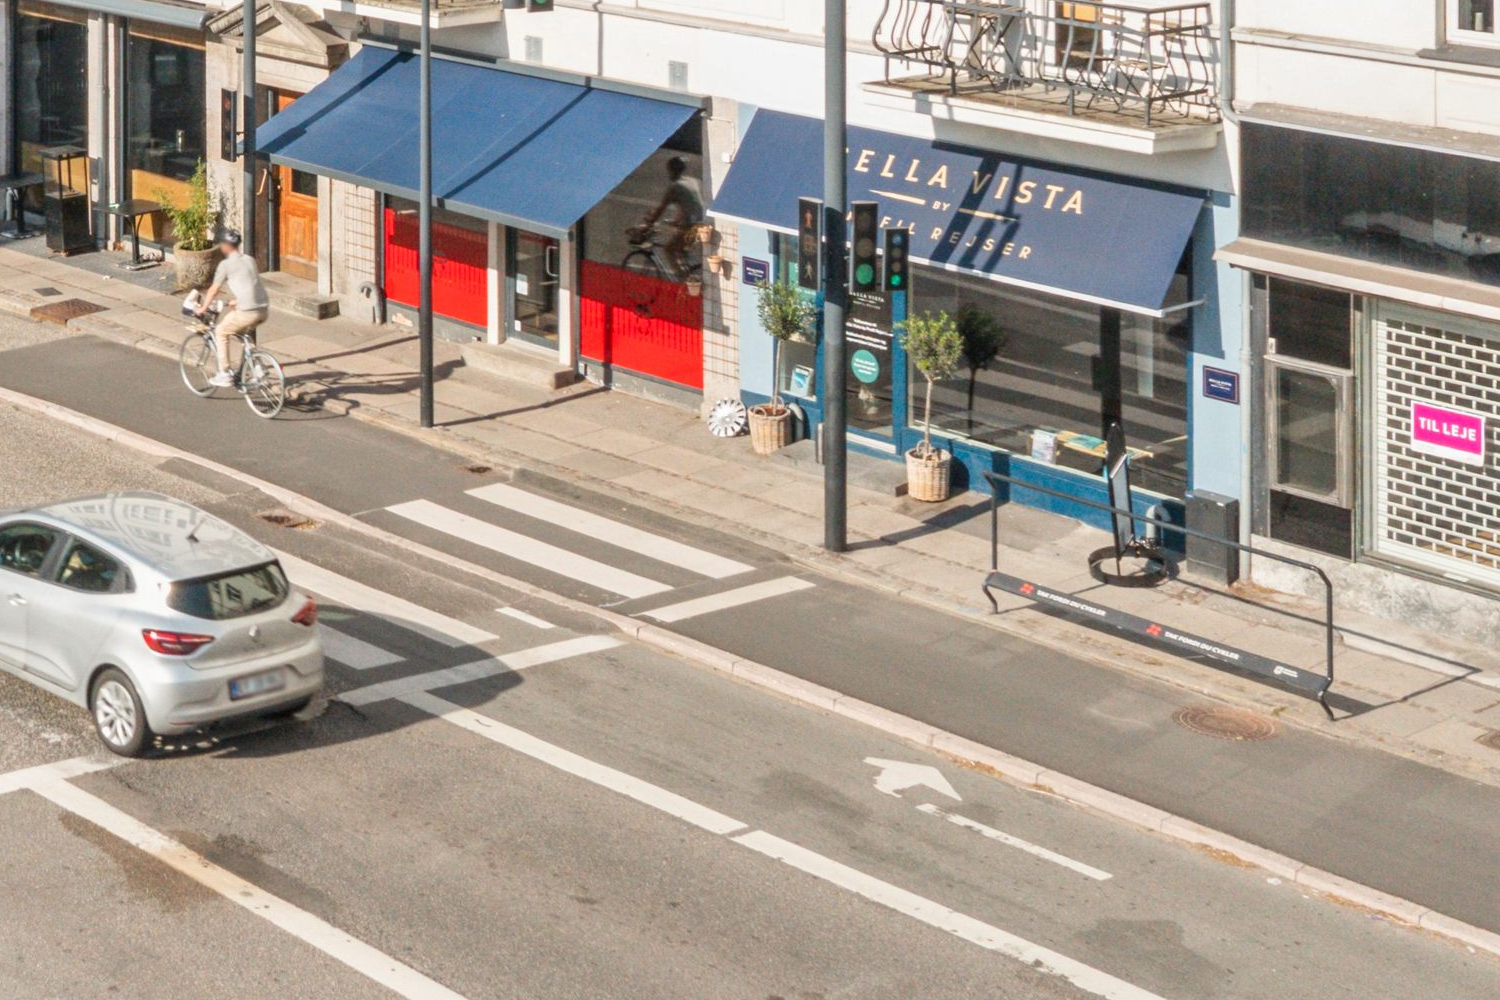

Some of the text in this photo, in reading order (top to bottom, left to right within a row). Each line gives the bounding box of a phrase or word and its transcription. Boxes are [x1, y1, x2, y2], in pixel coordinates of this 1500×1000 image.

[845, 147, 1083, 215] ELLA VISTA
[932, 200, 950, 212] BY
[930, 227, 1032, 260] REJSER
[1418, 416, 1477, 441] TIL LEJE
[1200, 643, 1213, 652] DU
